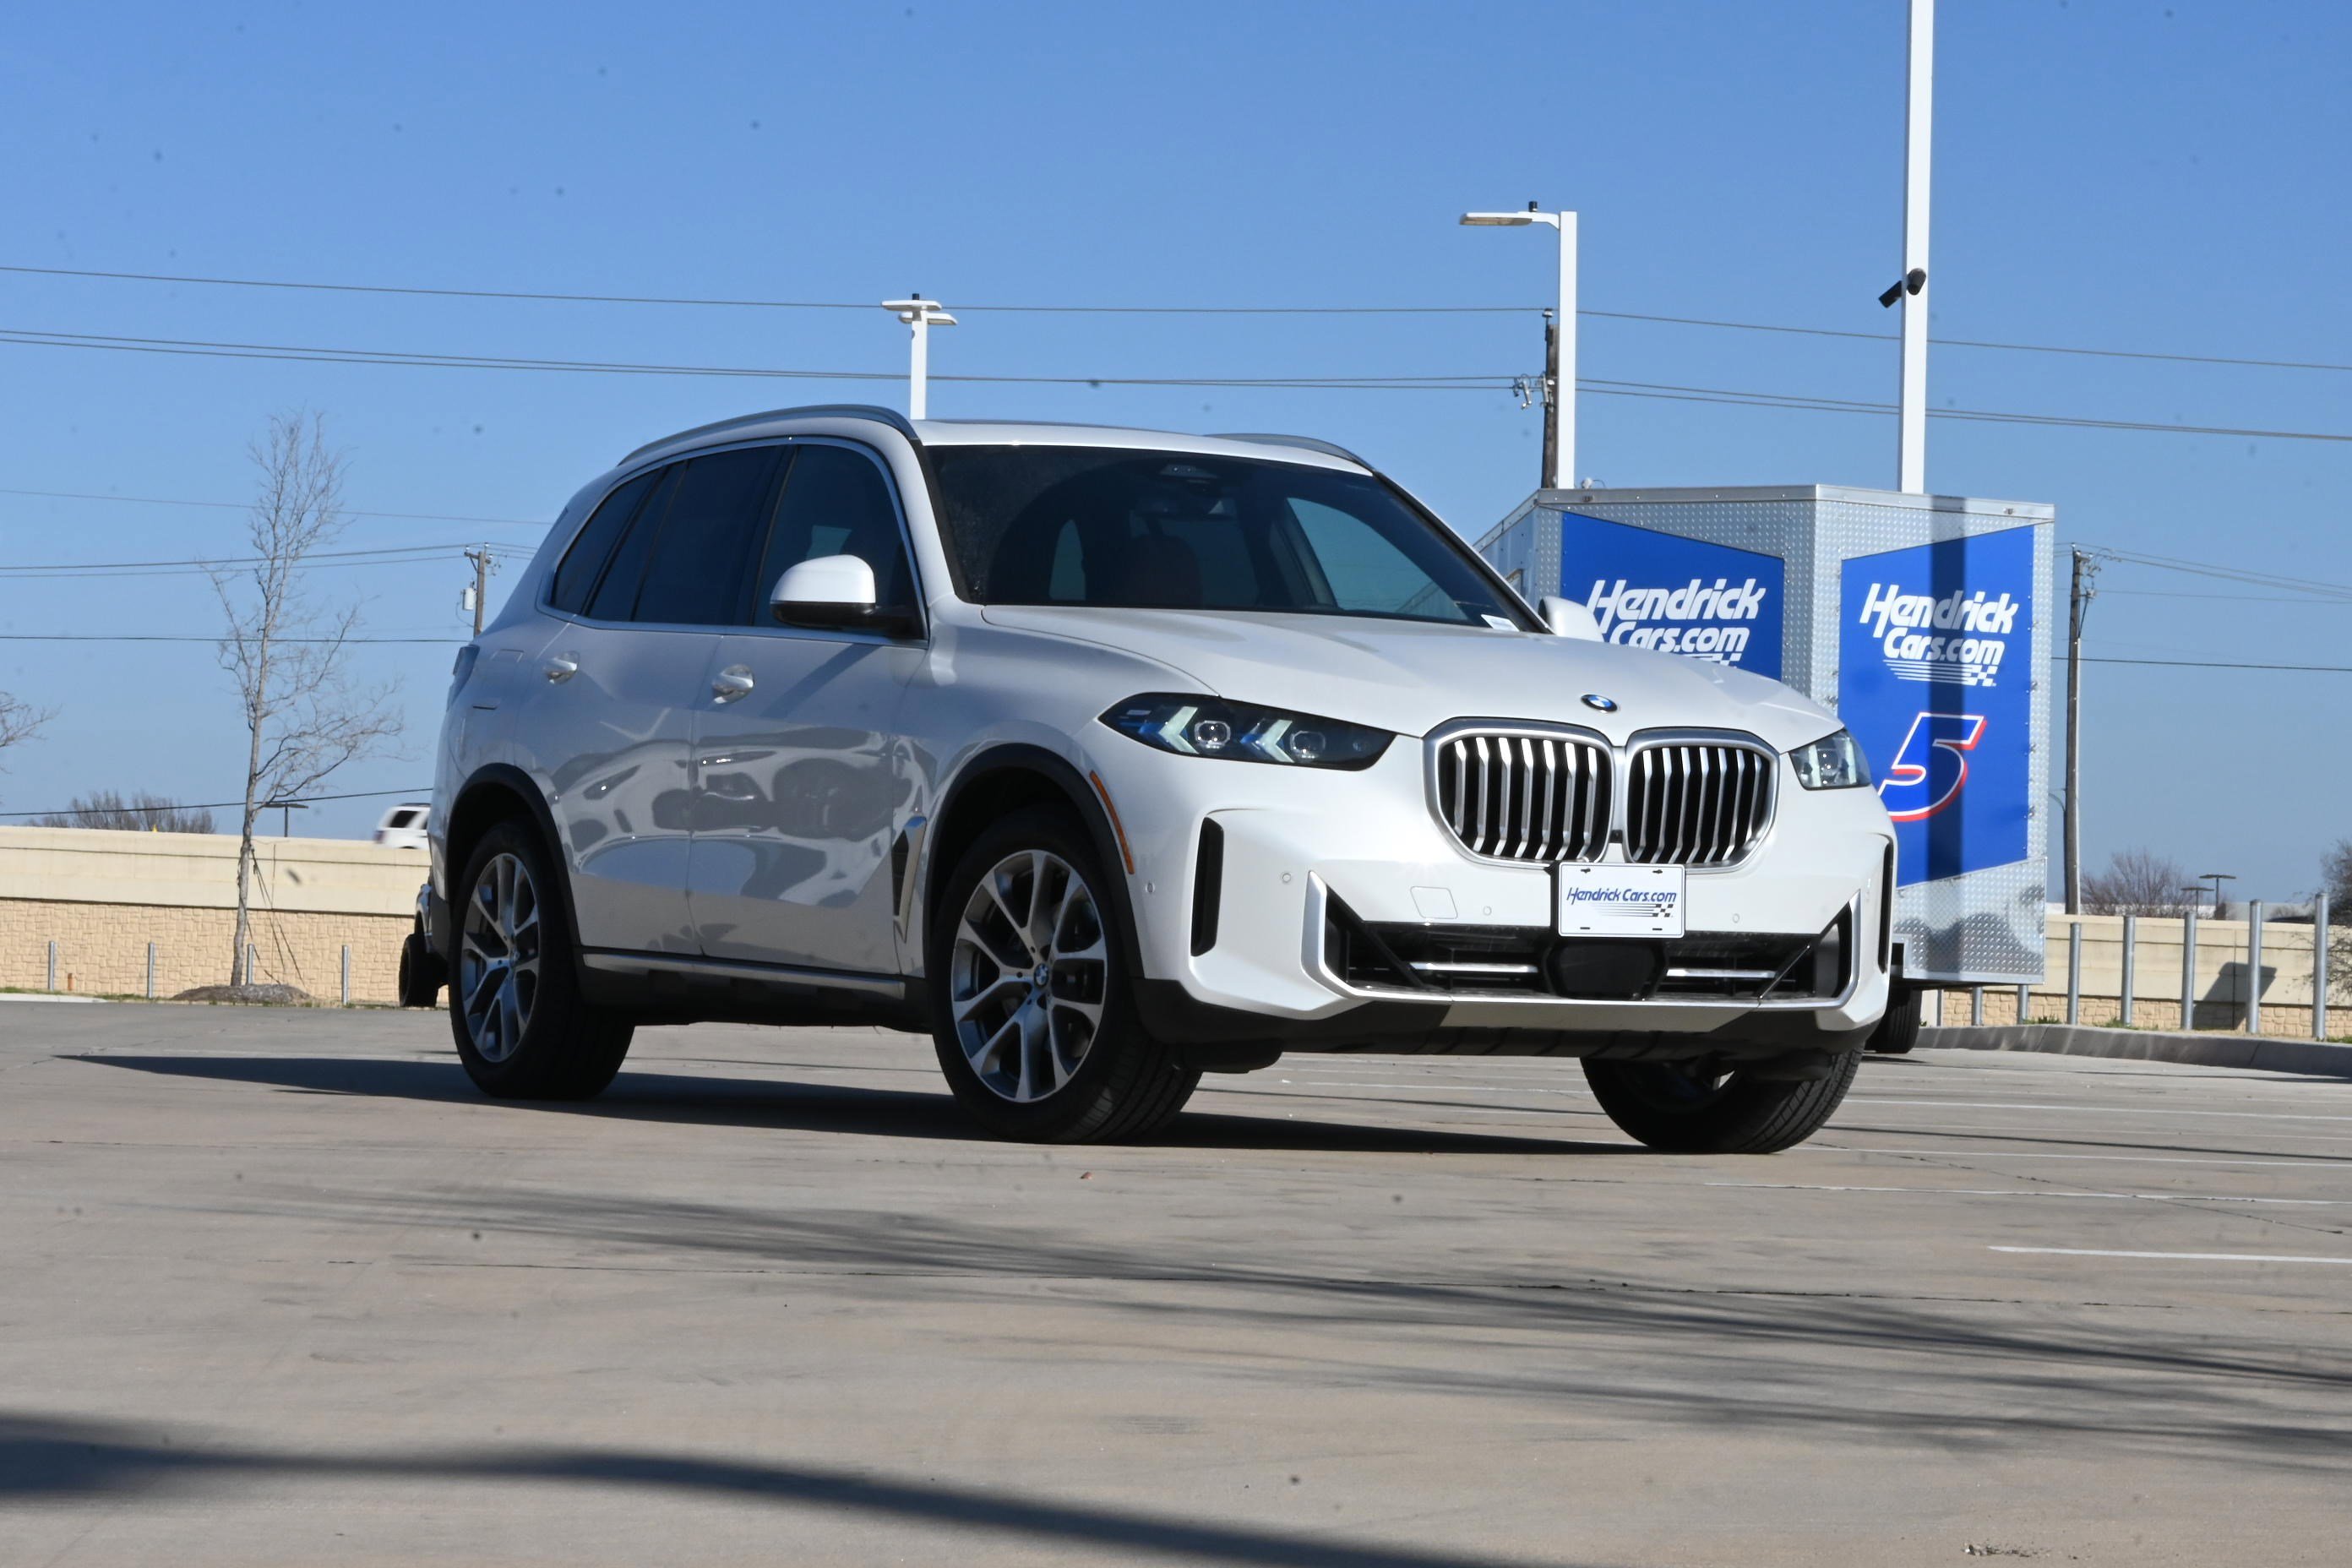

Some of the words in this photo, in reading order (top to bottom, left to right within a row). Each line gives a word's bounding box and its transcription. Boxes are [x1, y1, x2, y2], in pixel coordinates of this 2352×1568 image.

[1586, 578, 1767, 634] Hendrick
[1859, 582, 2019, 639] Hendrick
[1609, 621, 1750, 652] Cars.com
[1883, 627, 2006, 666] Cars.com
[1877, 711, 1987, 822] 5
